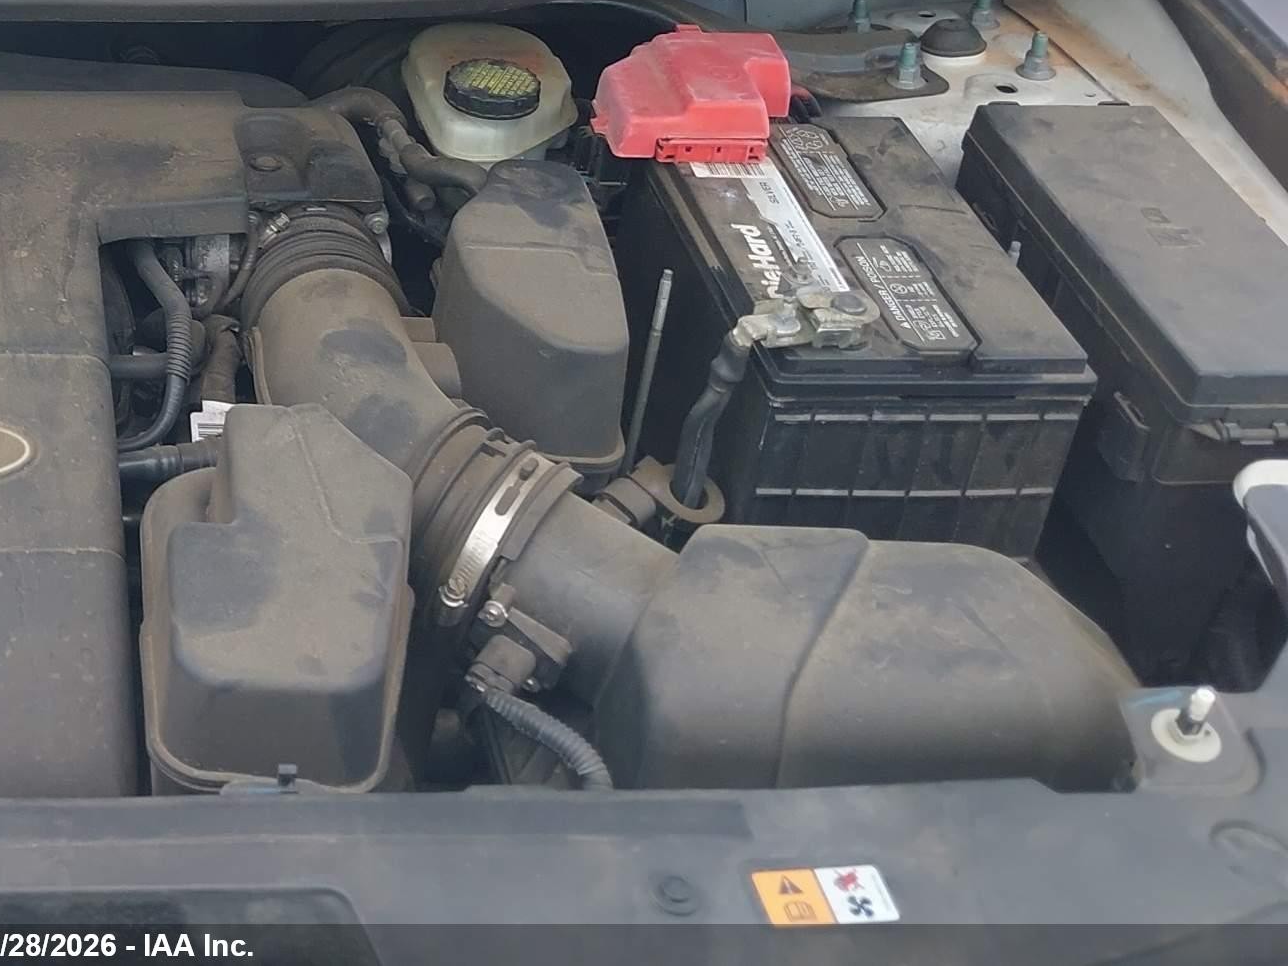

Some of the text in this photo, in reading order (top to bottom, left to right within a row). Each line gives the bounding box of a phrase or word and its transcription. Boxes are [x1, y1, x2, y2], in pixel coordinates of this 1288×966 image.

[759, 180, 780, 205] SILVER
[855, 255, 881, 283] POISON
[878, 289, 907, 322] DANGER
